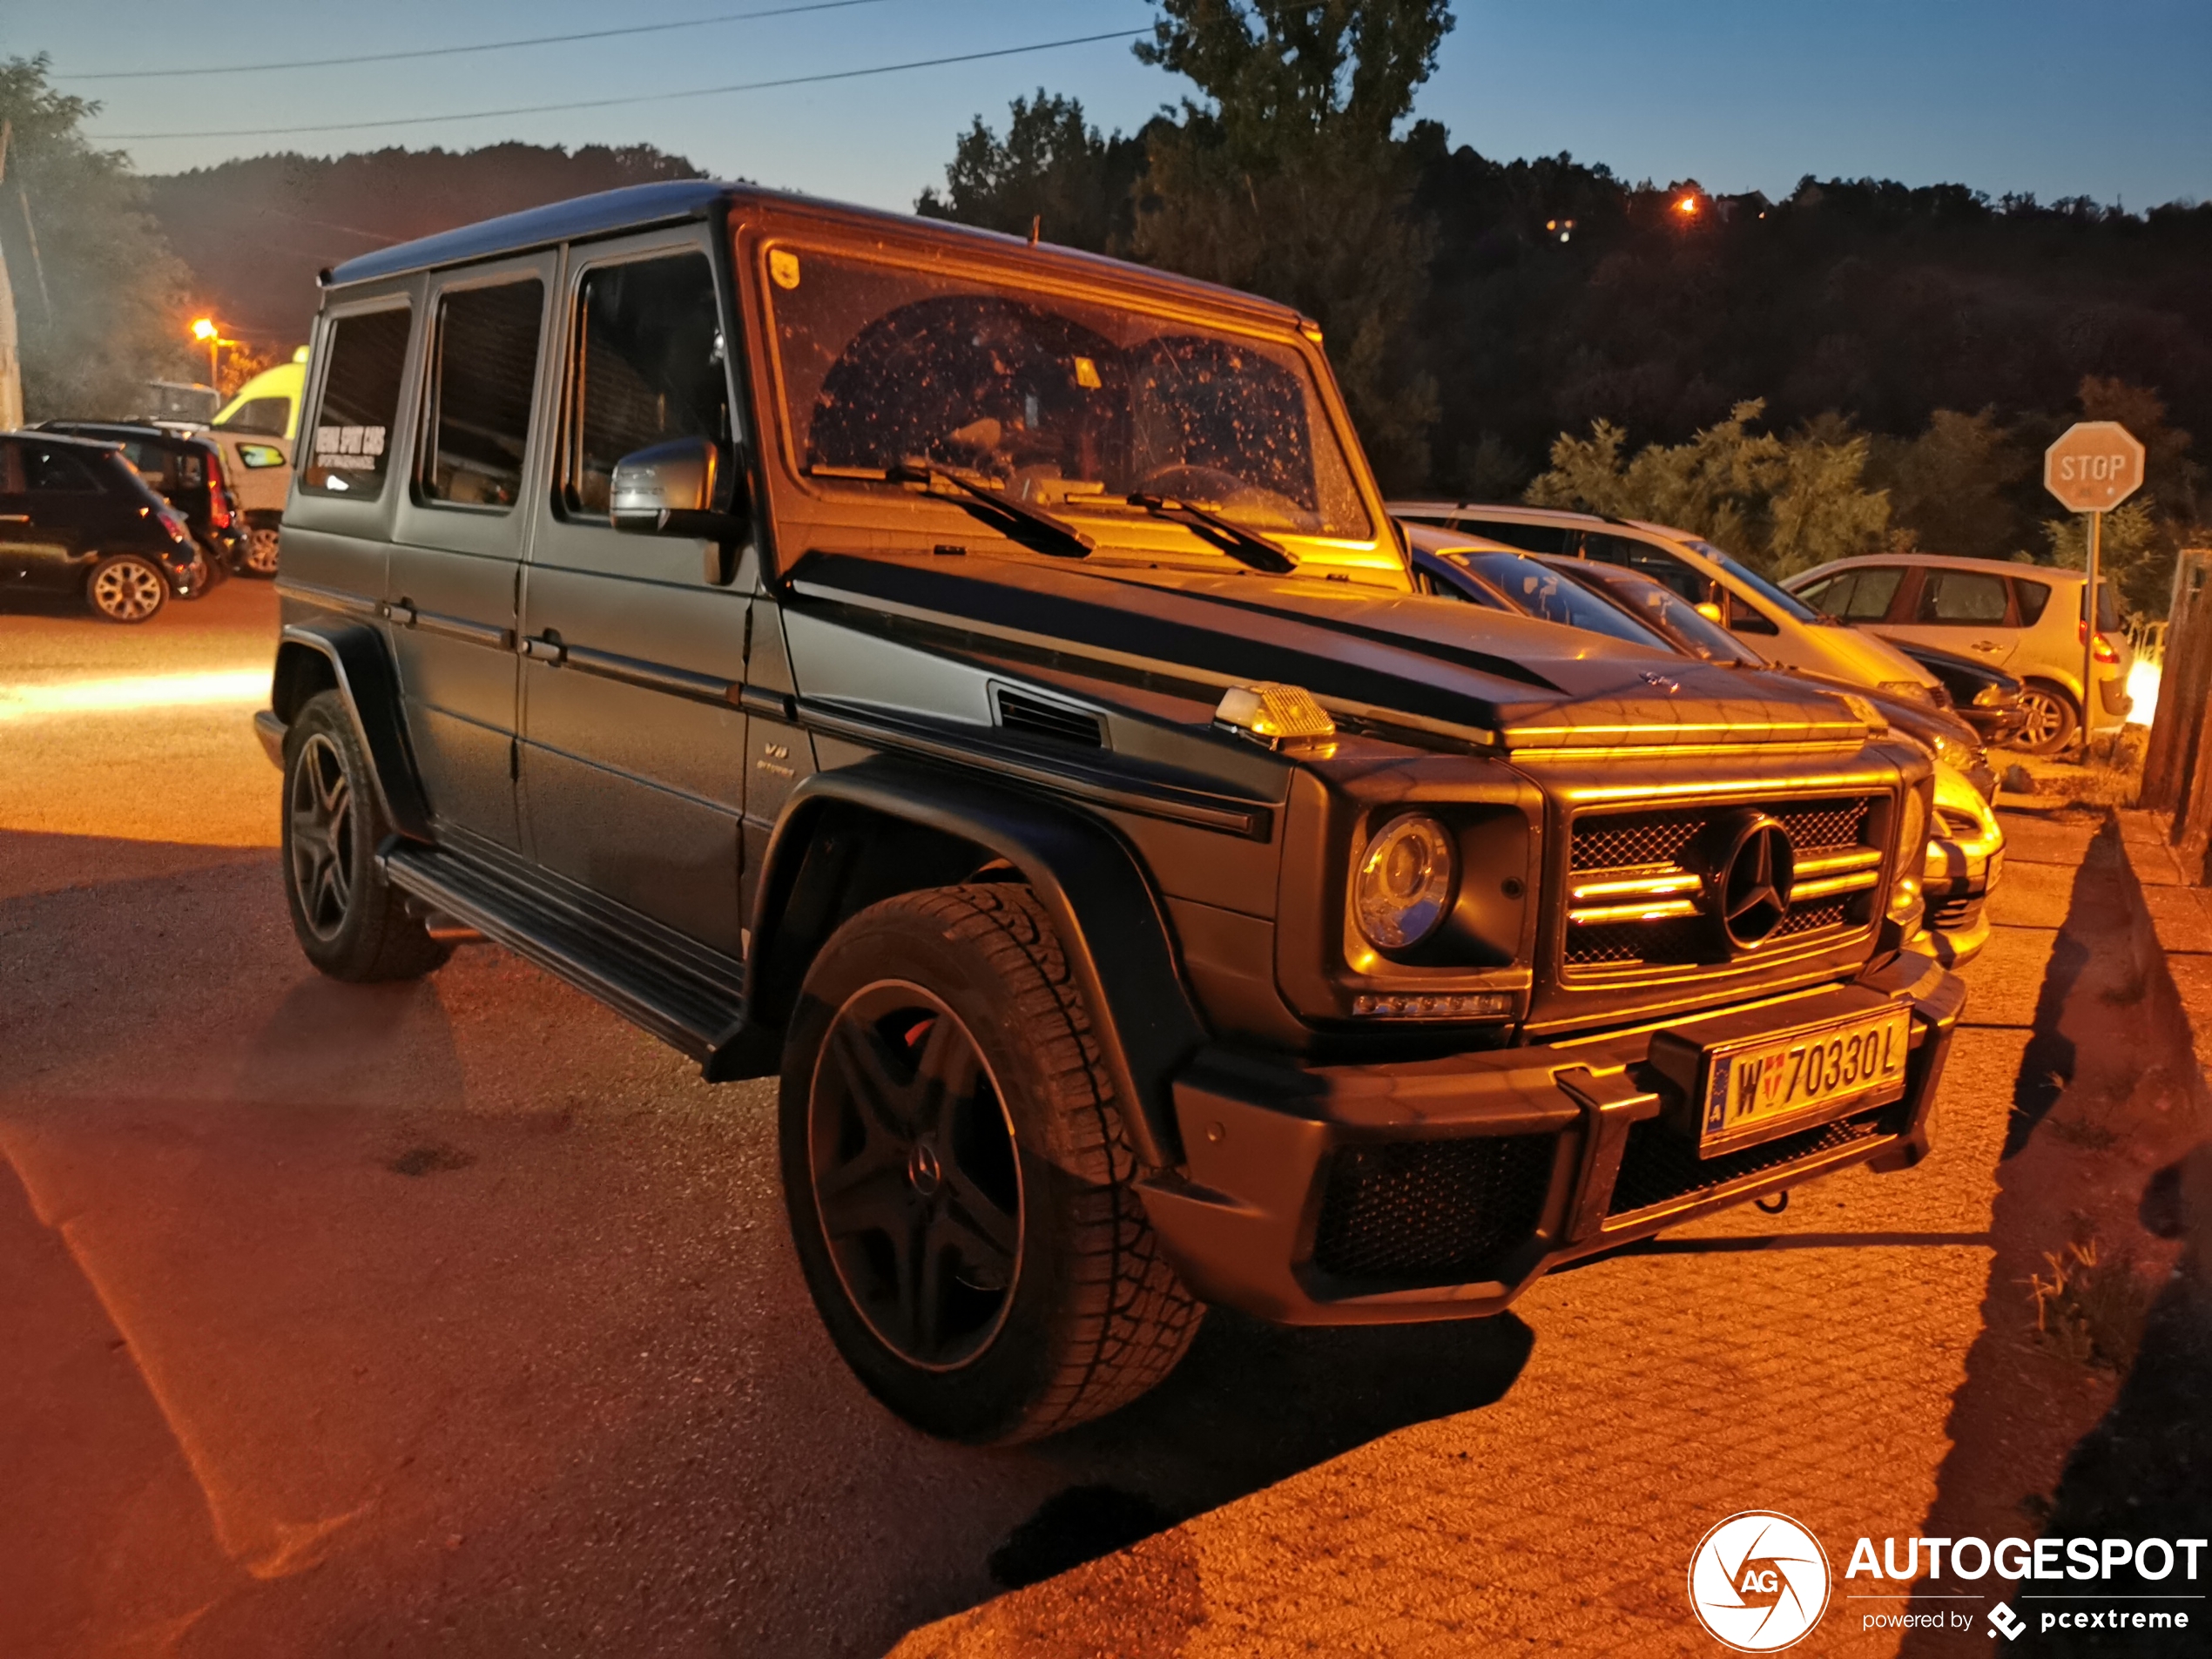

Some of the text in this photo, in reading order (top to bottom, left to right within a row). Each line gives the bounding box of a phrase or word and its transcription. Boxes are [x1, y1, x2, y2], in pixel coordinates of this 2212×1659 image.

[2060, 455, 2126, 481] STOP
[1737, 1022, 1895, 1116] W 70330L
